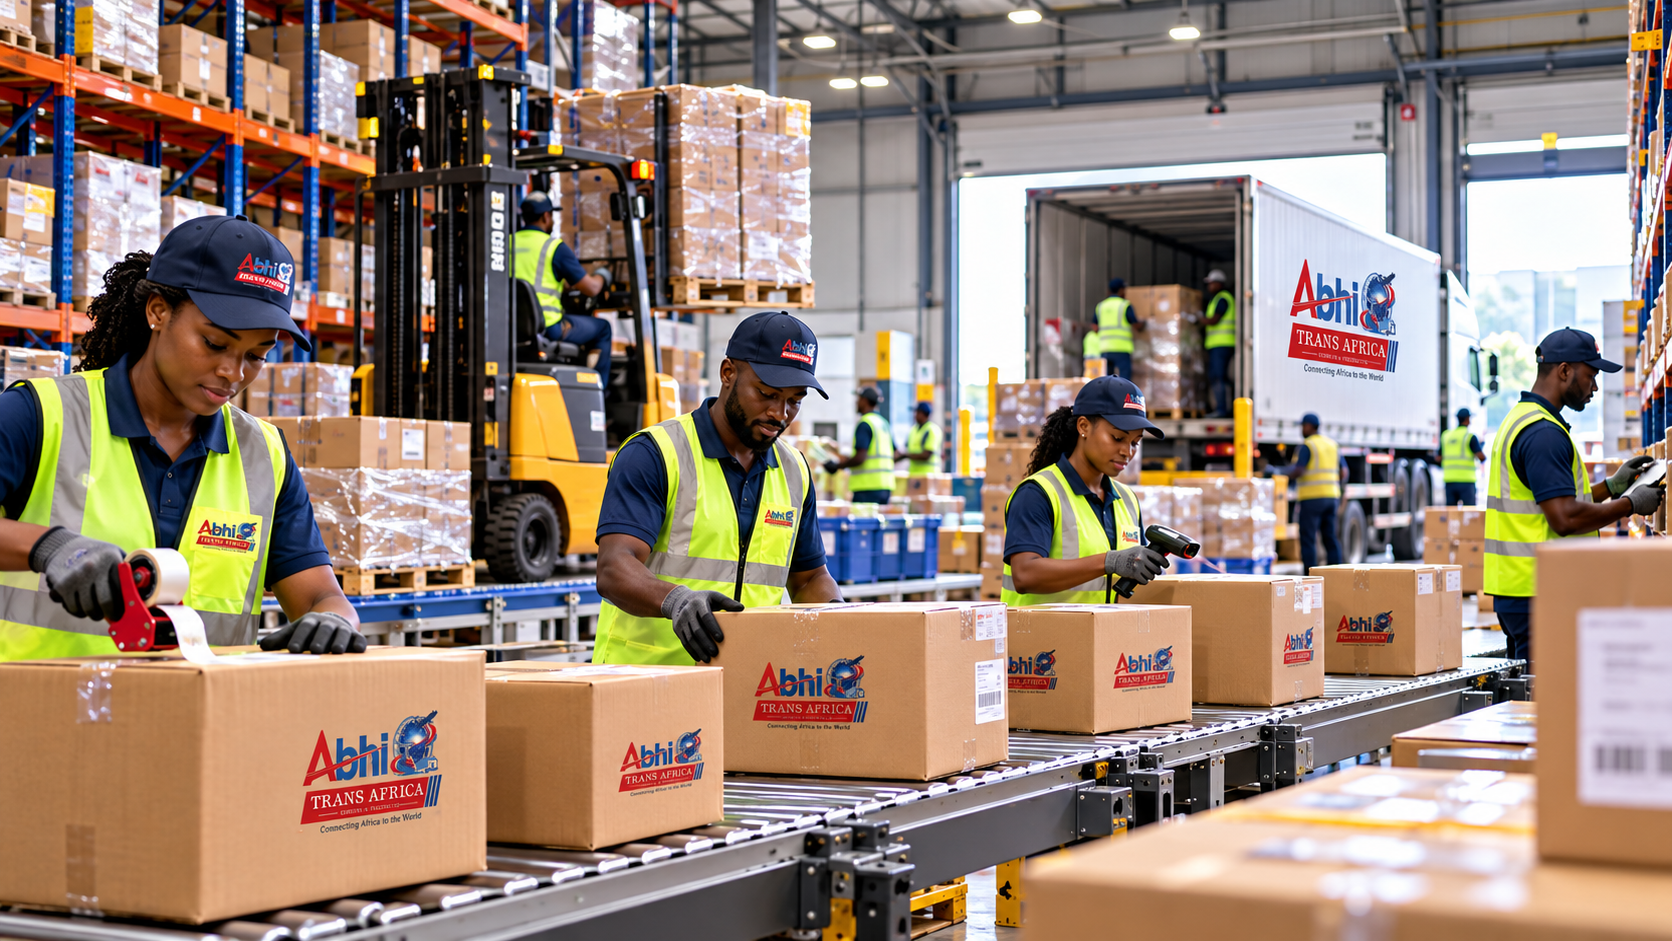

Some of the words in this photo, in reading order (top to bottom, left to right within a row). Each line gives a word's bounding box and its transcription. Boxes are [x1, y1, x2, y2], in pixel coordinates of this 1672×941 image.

[1289, 258, 1358, 326] Abhi
[1296, 329, 1340, 350] TRANS
[1342, 338, 1387, 358] AFRICA
[1303, 363, 1335, 378] Connecting
[1352, 370, 1359, 379] to
[197, 519, 236, 539] Abhi
[1336, 614, 1372, 633] Abhi
[1114, 652, 1152, 675] Abhi
[754, 661, 823, 697] Abhi
[761, 703, 803, 714] TRANS
[805, 704, 853, 715] AFRICA
[303, 729, 388, 786] Abhi
[620, 741, 673, 772] Abhi
[625, 772, 657, 785] TRANS
[310, 789, 364, 810] TRANS
[368, 782, 424, 803] AFRICA
[319, 821, 360, 834] Connecting
[360, 817, 381, 828] Africa
[382, 816, 389, 825] to
[390, 814, 401, 823] the
[402, 812, 422, 822] World
